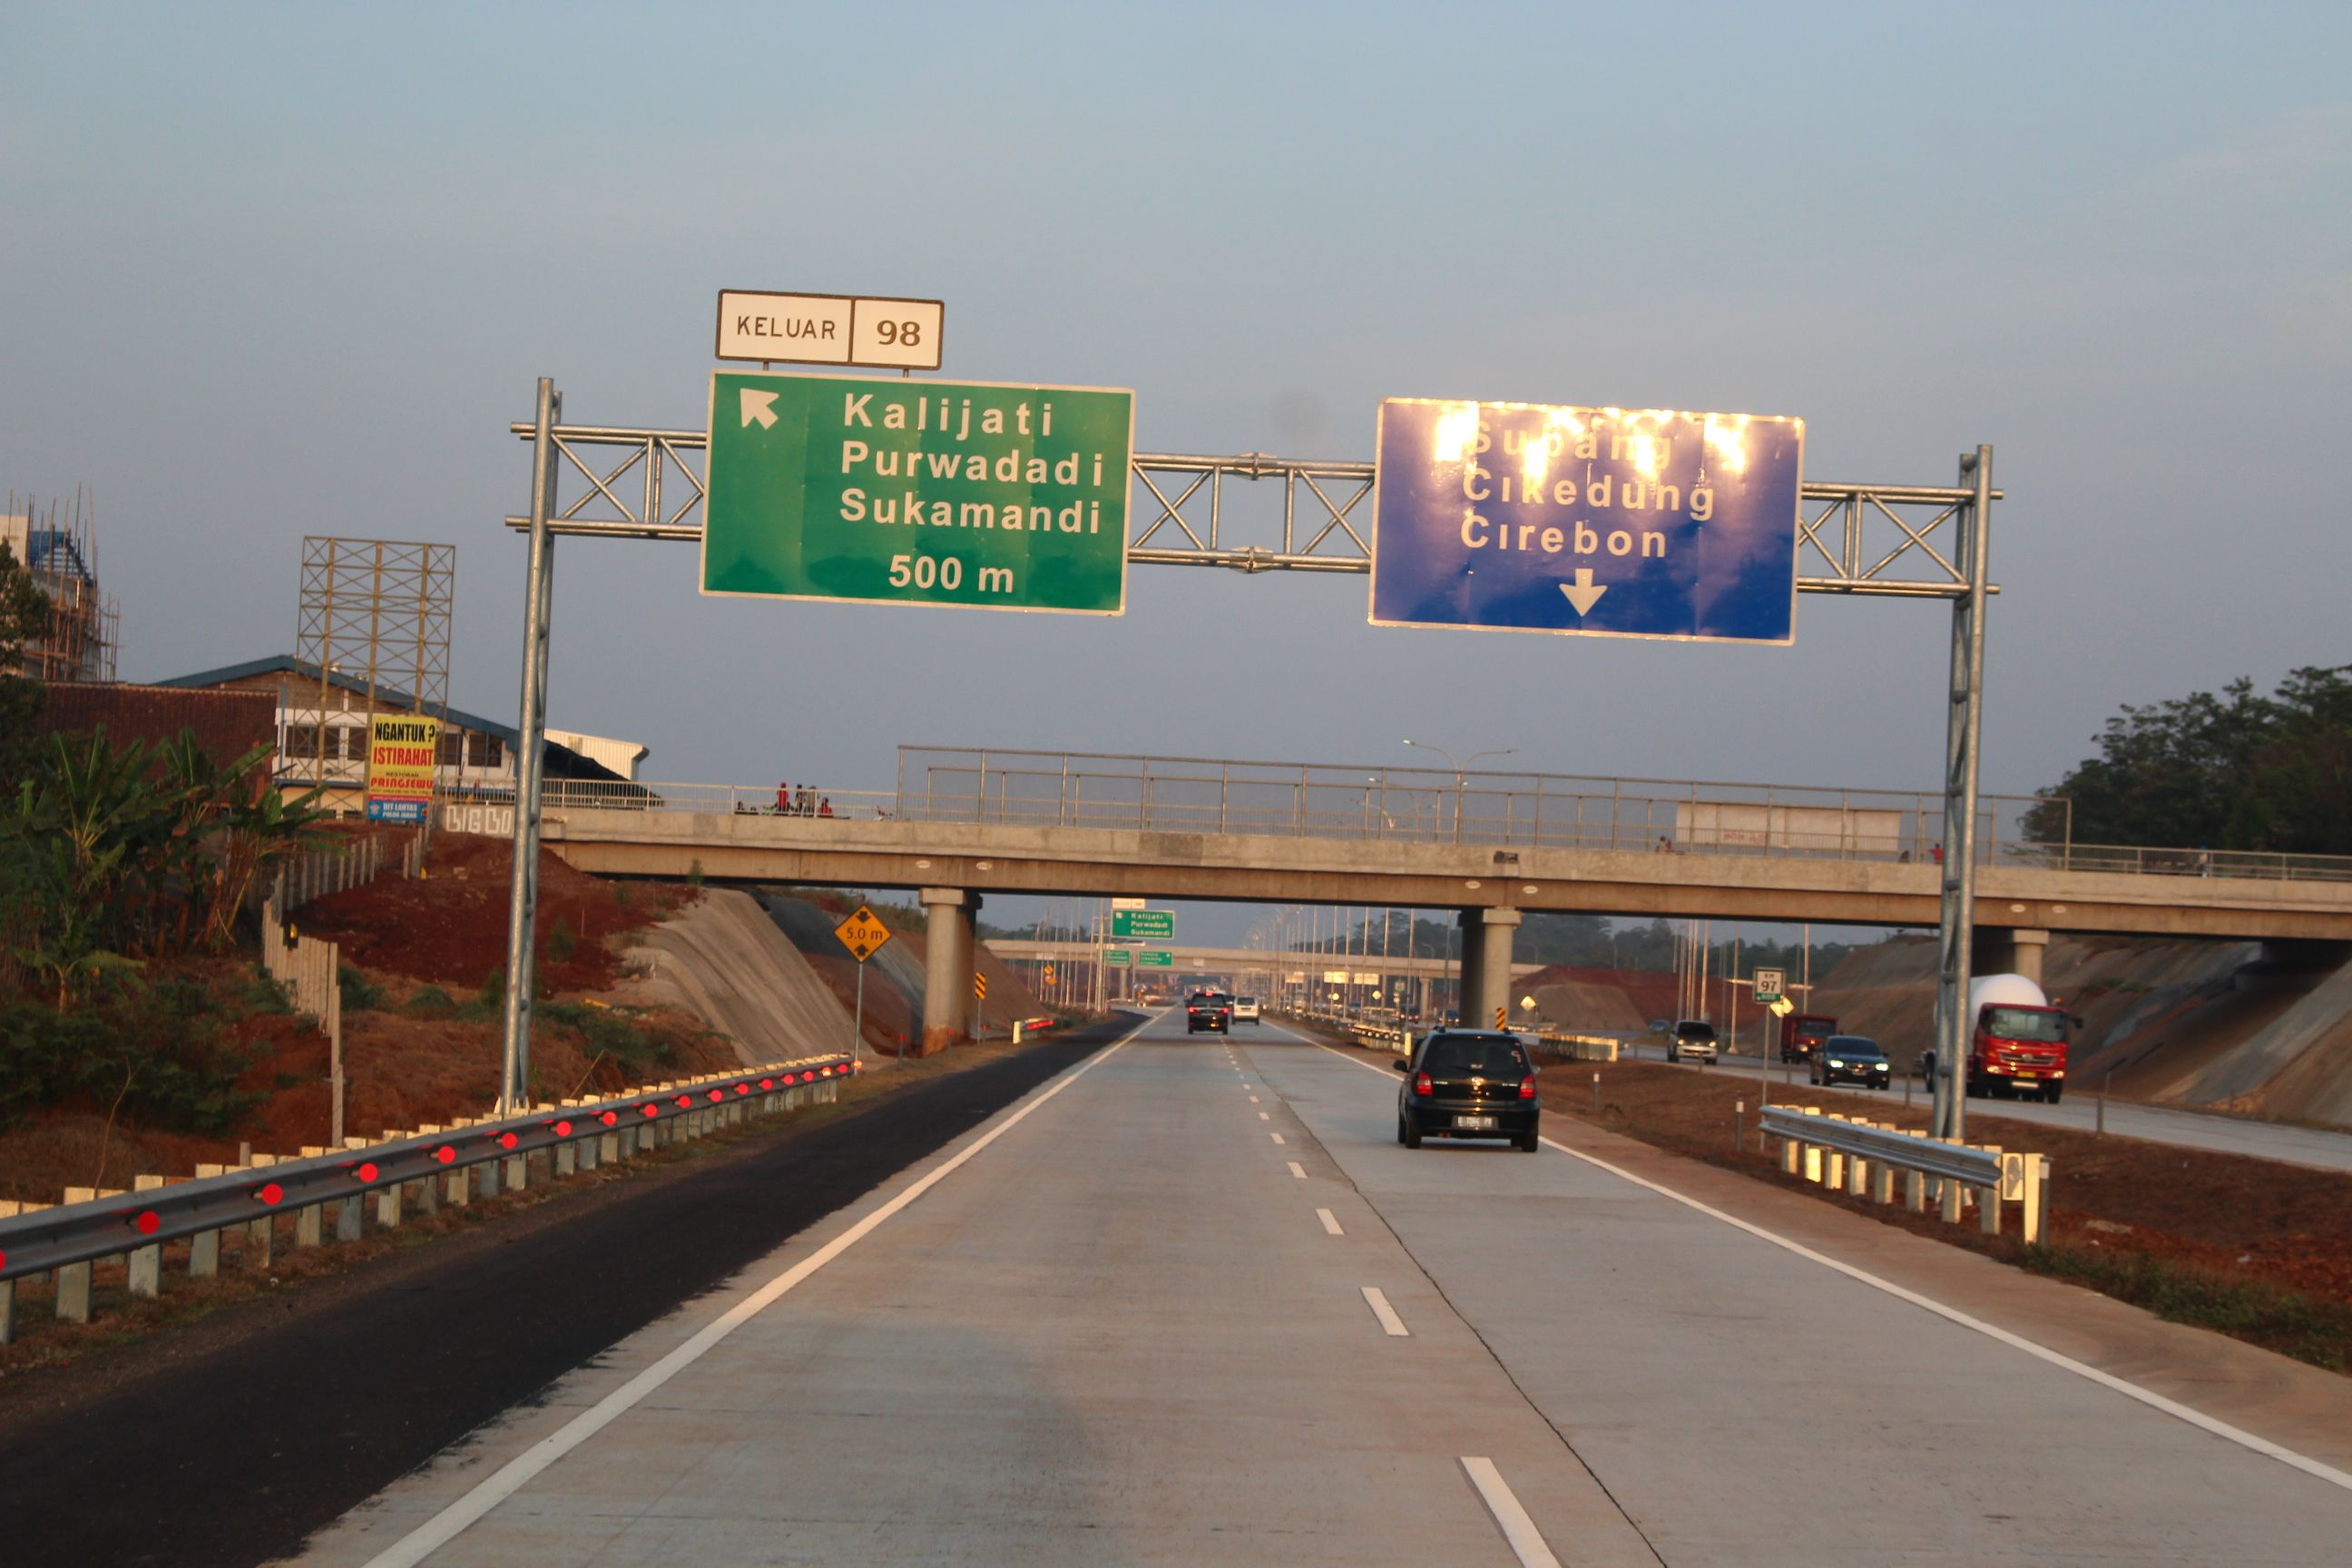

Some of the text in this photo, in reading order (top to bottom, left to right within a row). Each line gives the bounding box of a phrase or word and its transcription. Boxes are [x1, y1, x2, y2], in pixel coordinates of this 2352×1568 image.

[736, 315, 836, 340] KELUAR
[876, 318, 922, 347] 98
[843, 392, 1052, 441] Kalijati
[841, 440, 1102, 487] Purwadadi
[1462, 467, 1715, 522] Cikedung
[839, 487, 1101, 534] Sukamandi
[1459, 514, 1667, 559] Cirebon
[887, 554, 1014, 593] 500 m
[374, 722, 426, 742] NGANTUK
[373, 747, 434, 767] ISTIRAHAT
[370, 778, 434, 789] PRINGSEWU
[846, 926, 883, 941] 5.0 m
[1760, 980, 1777, 992] 97
